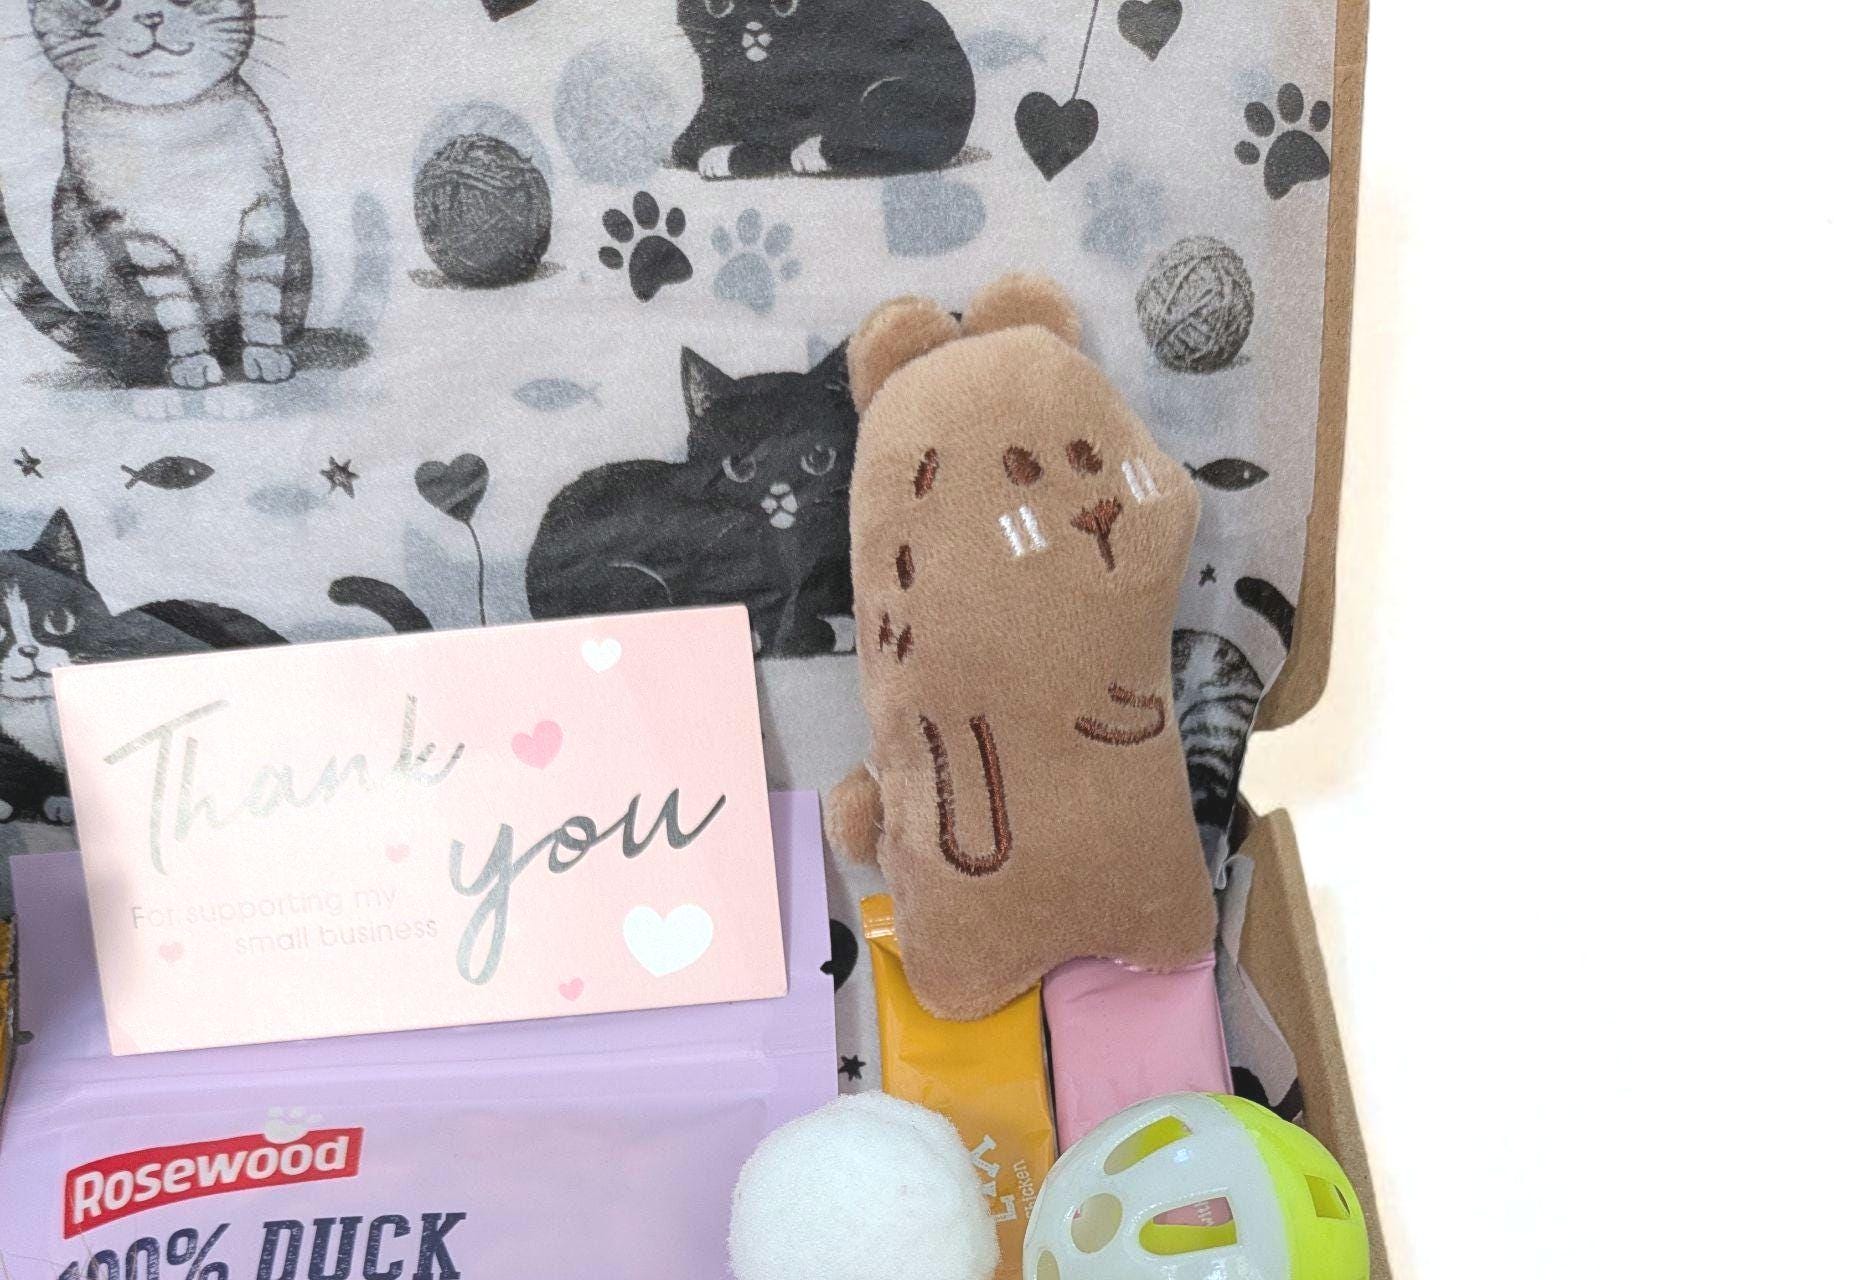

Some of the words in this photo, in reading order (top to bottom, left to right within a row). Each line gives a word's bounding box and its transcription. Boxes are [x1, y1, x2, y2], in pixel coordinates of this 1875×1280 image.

[103, 692, 466, 877] Thank
[131, 905, 175, 930] For
[185, 889, 344, 927] supporting
[354, 887, 398, 912] my
[449, 787, 728, 987] you
[235, 927, 309, 956] small
[319, 917, 439, 948] business
[71, 1135, 350, 1225] Rosewood
[1012, 1158, 1037, 1219] icken
